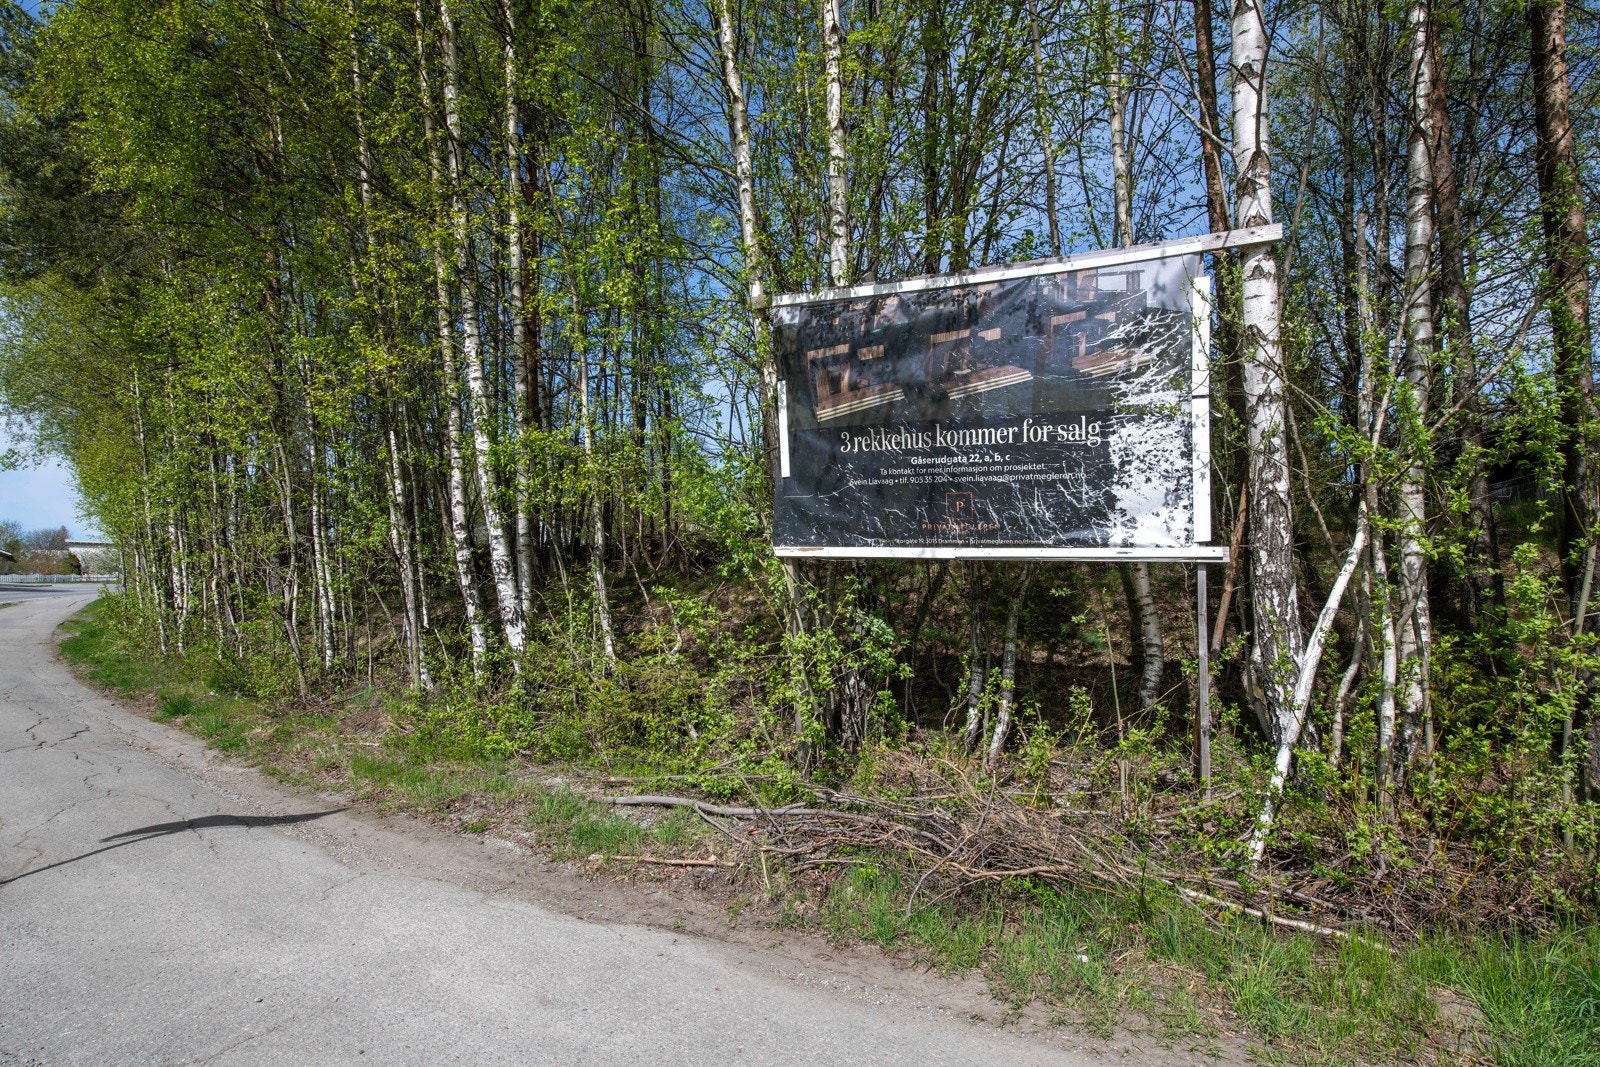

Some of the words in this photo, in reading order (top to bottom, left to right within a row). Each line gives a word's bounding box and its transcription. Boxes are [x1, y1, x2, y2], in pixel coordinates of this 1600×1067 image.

[841, 431, 851, 453] 3
[853, 427, 932, 452] rekkehus
[935, 424, 1019, 448] kommer
[1022, 418, 1053, 442] for
[1057, 416, 1101, 447] salg
[910, 455, 967, 466] Gåserudgata
[969, 453, 982, 463] 22,
[984, 455, 993, 463] a,
[994, 452, 1004, 462] b,
[888, 467, 915, 475] kontakt
[916, 466, 927, 474] for
[943, 464, 988, 474] informasjon
[1004, 462, 1048, 473] prosjektet.
[899, 476, 909, 484] tlf.
